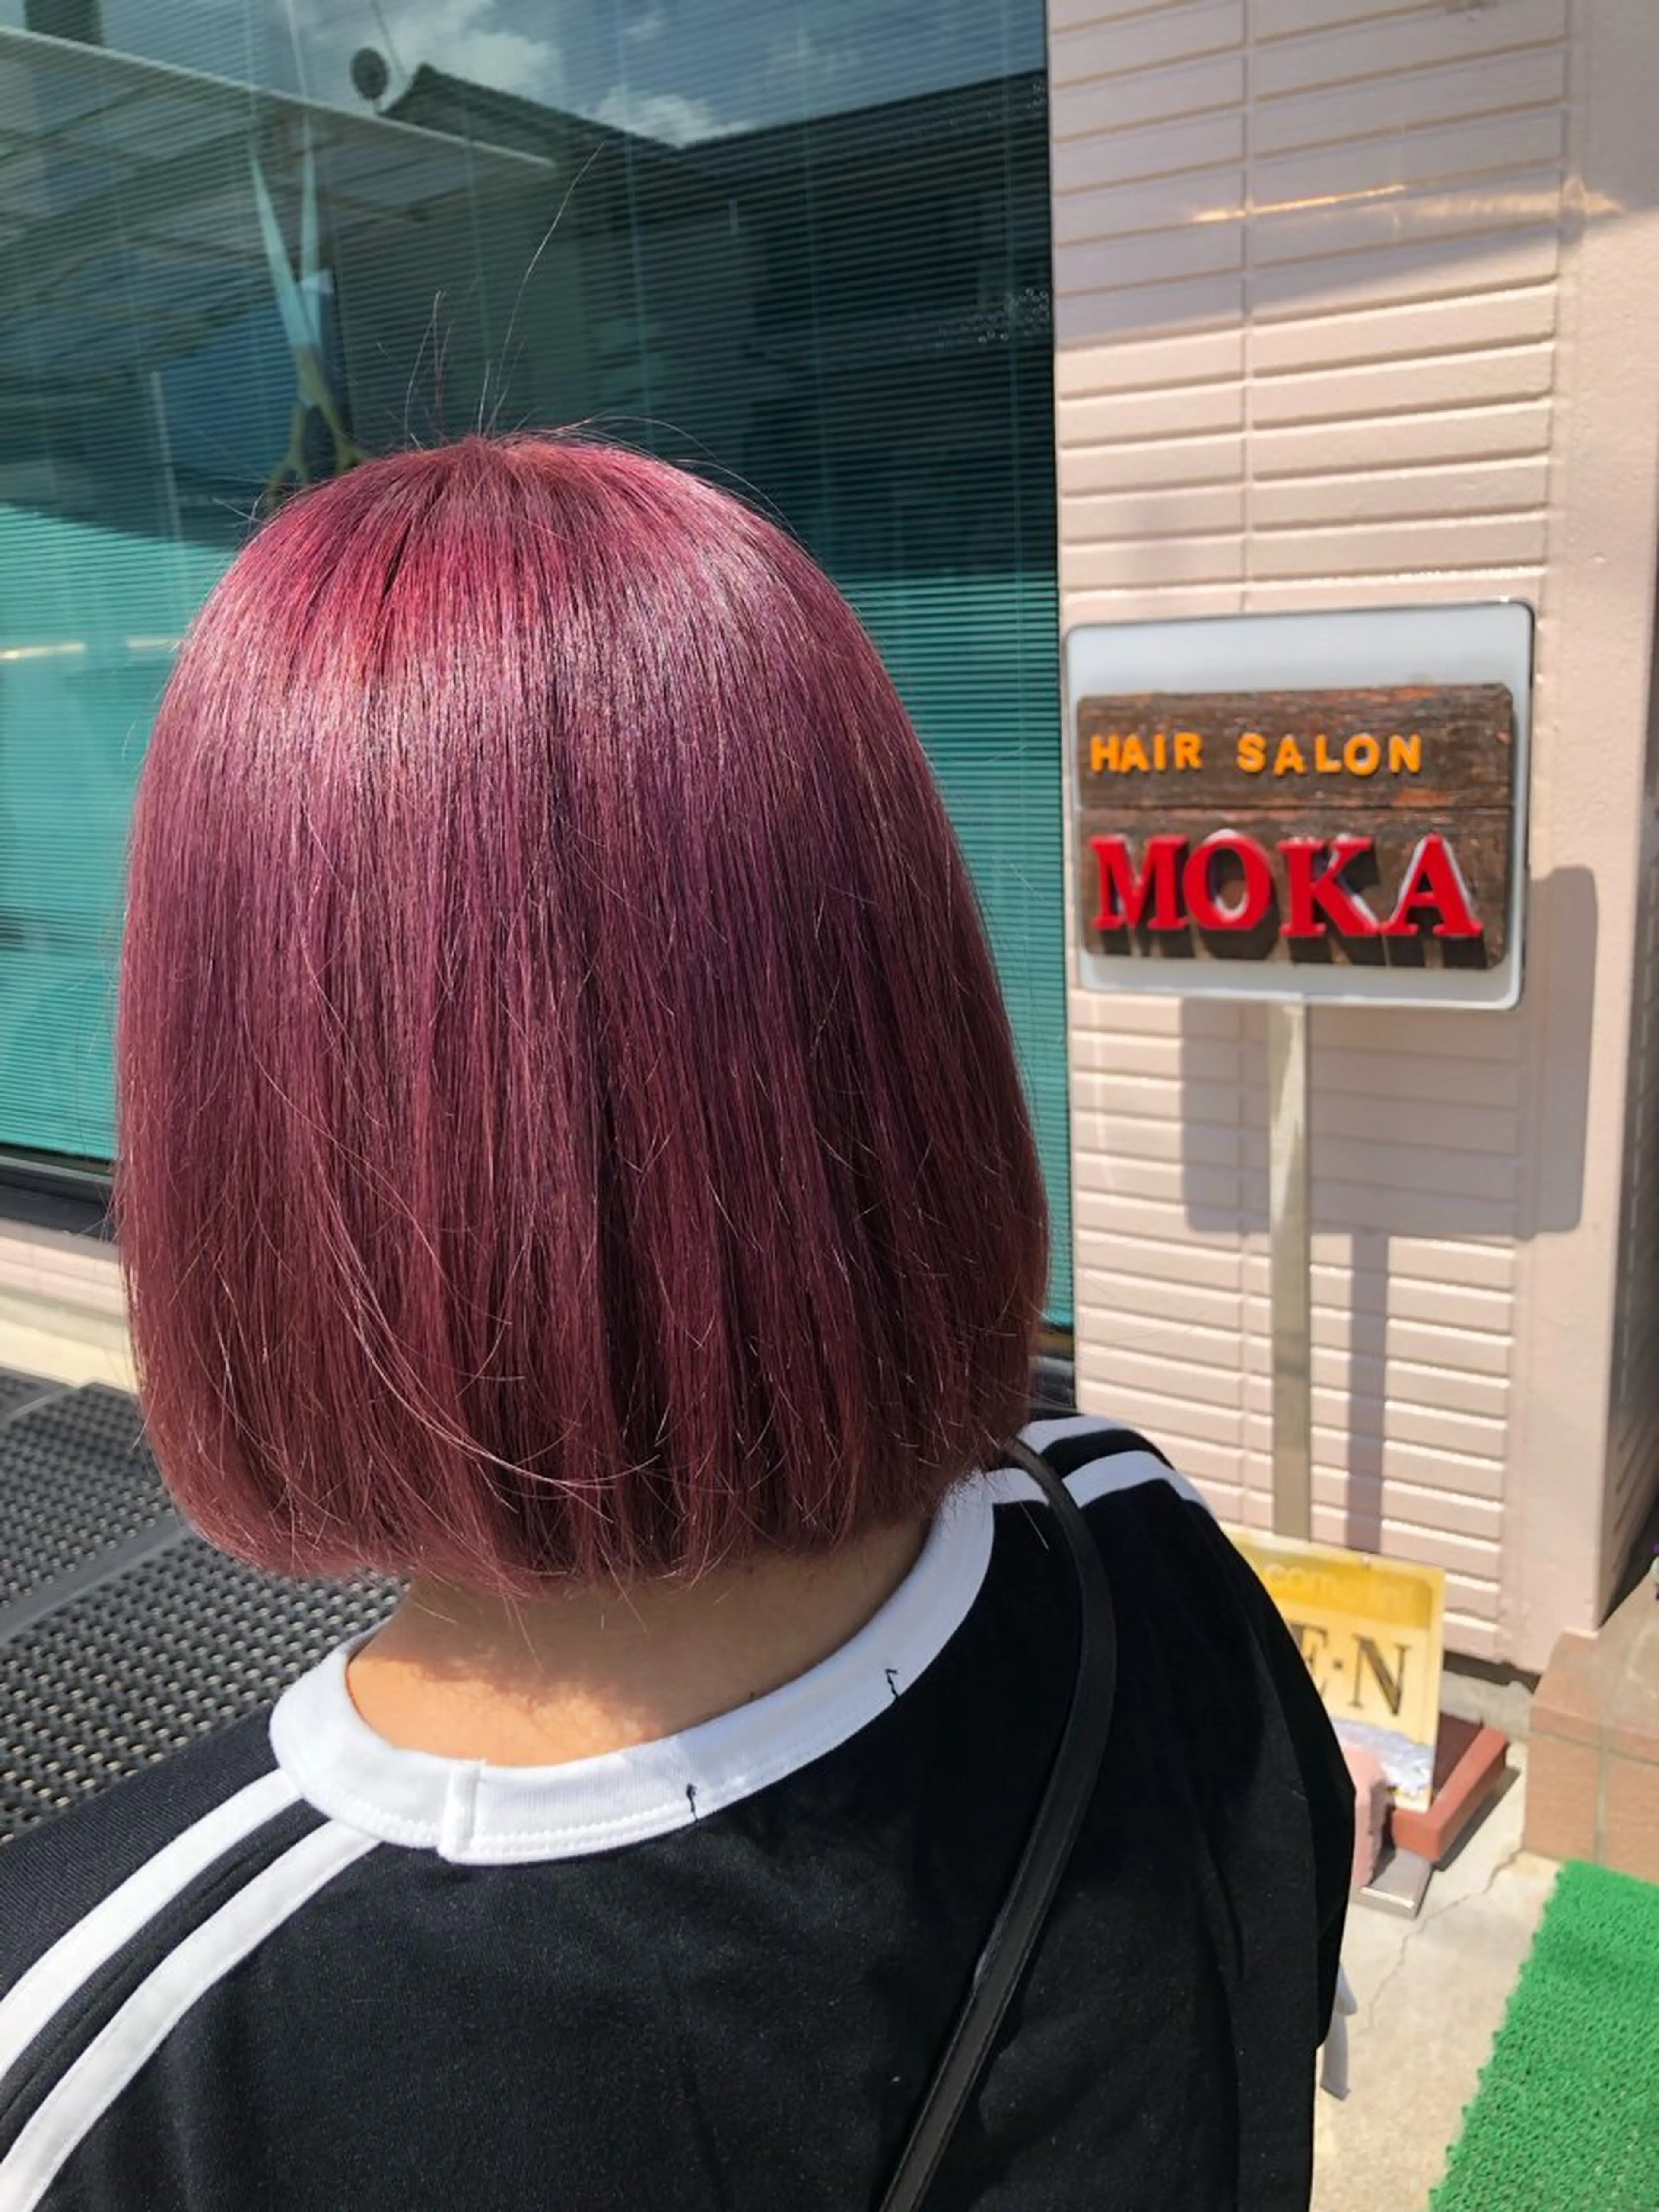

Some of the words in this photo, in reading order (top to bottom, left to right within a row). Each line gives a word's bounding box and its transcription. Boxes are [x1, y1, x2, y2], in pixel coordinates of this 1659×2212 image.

[1090, 731, 1203, 772] HAIR
[1236, 732, 1422, 776] SALON
[1089, 828, 1484, 938] MOKA
